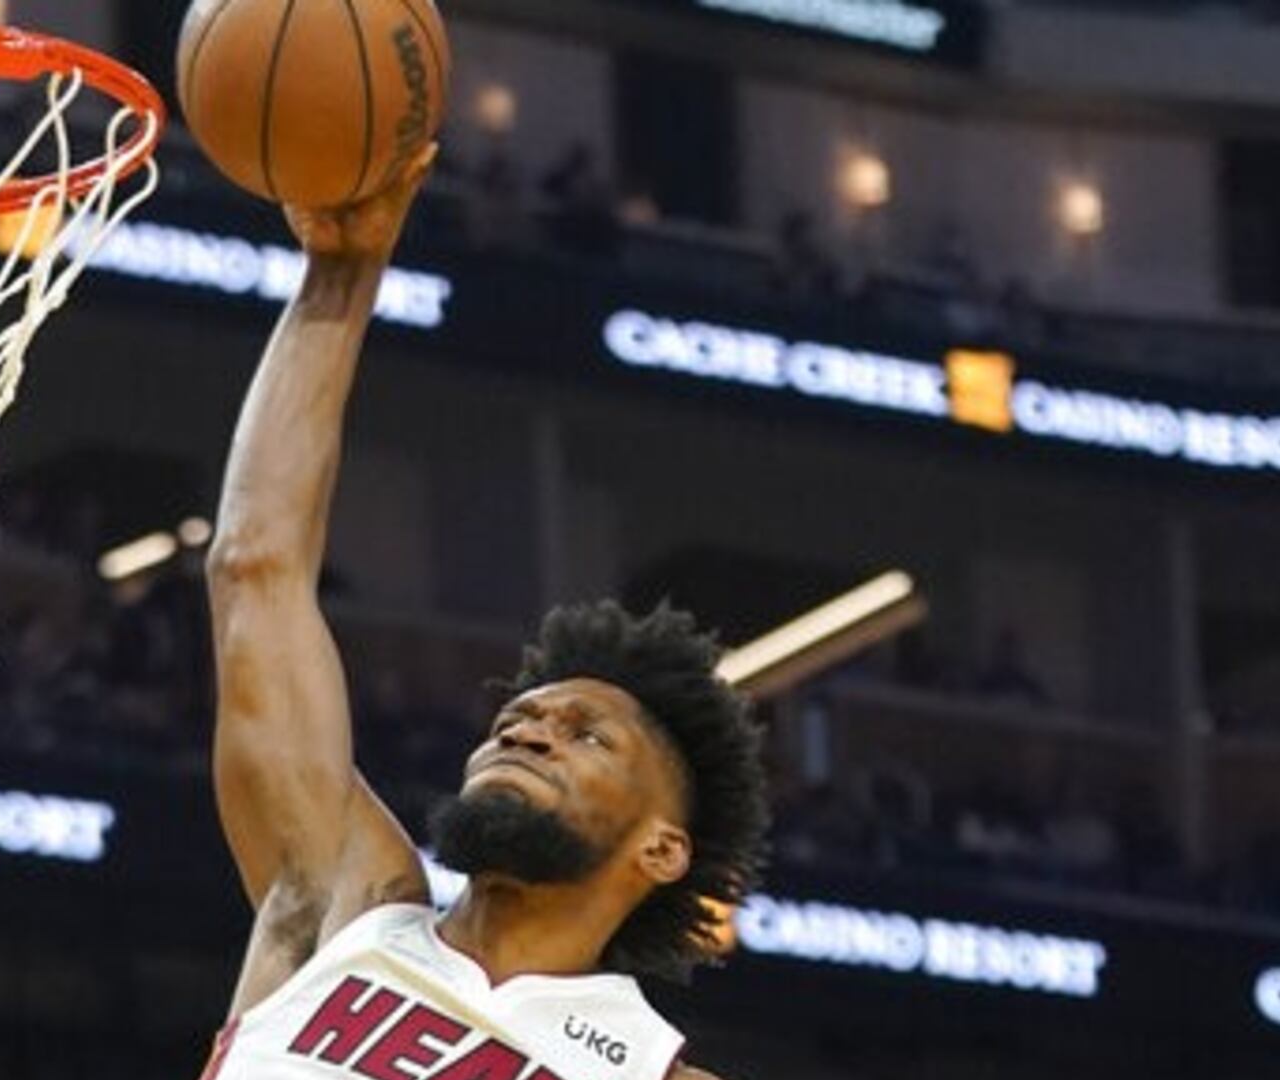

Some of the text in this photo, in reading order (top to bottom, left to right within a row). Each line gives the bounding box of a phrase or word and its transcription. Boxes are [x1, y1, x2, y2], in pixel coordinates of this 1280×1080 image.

[605, 311, 787, 386] CACHE
[1011, 381, 1180, 455] CASINO
[921, 918, 1105, 996] RESORT
